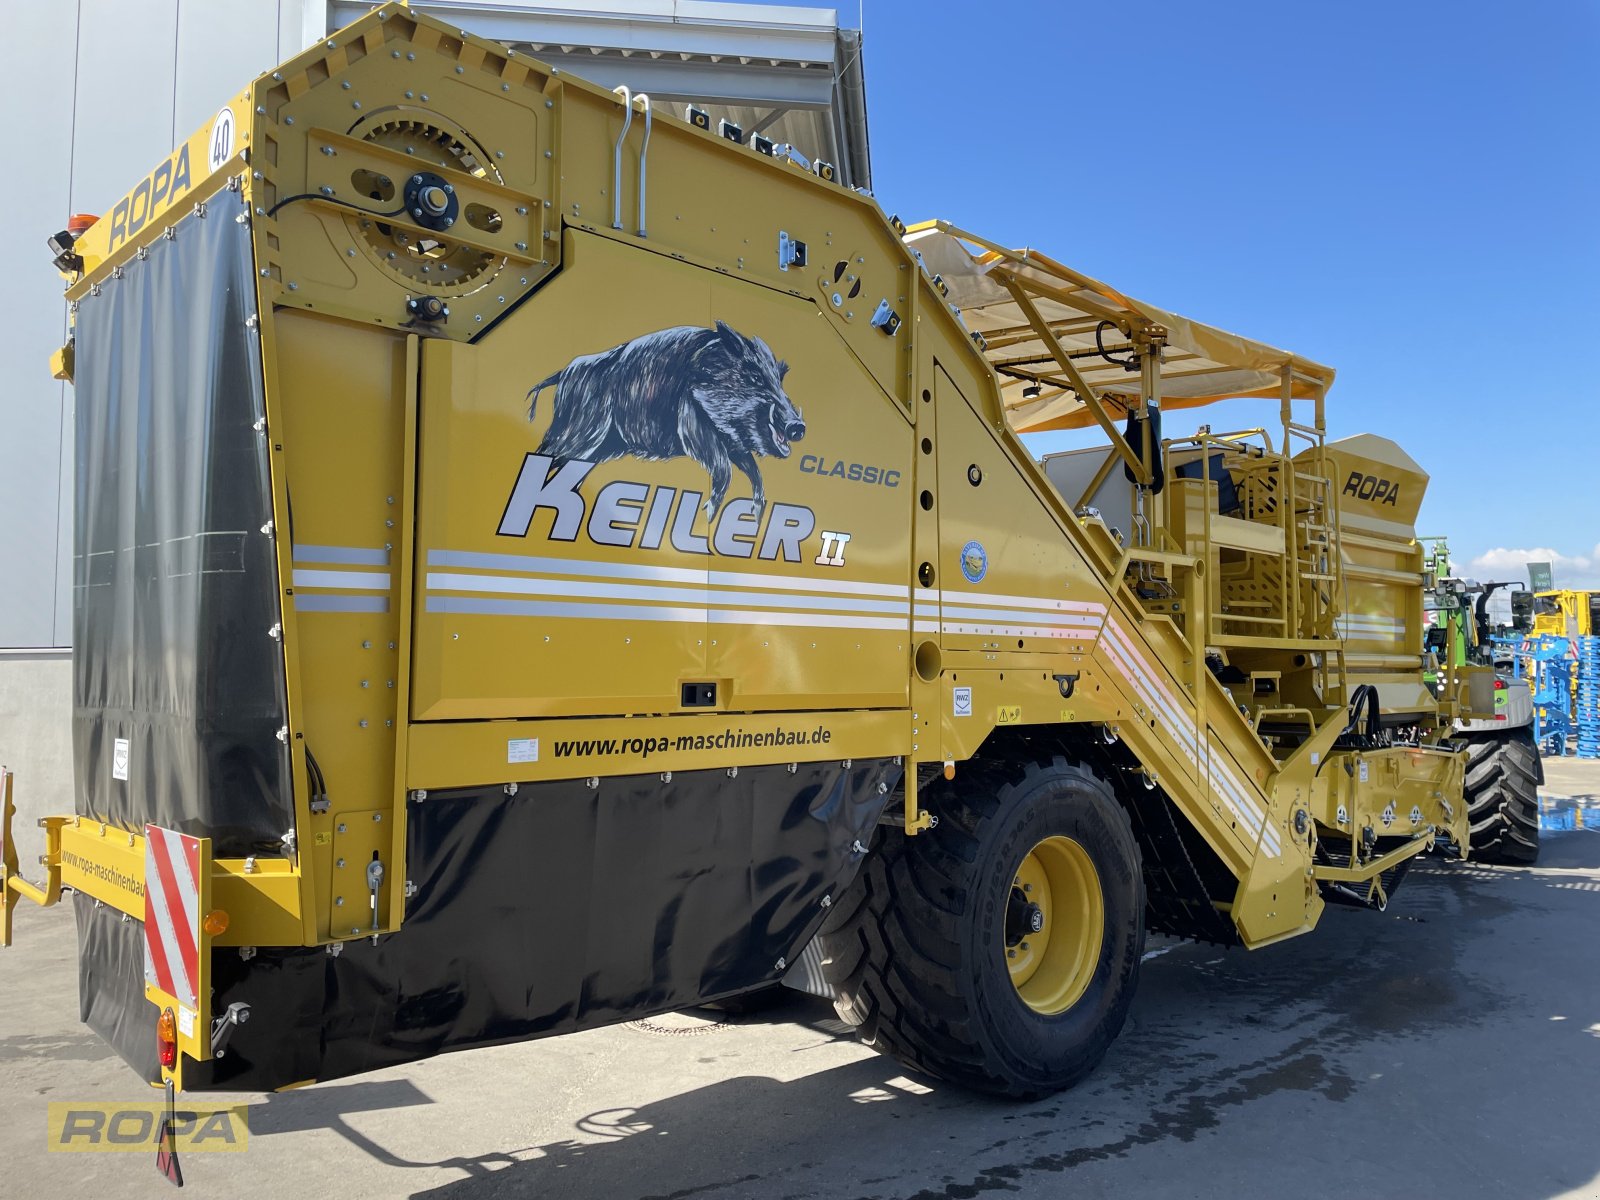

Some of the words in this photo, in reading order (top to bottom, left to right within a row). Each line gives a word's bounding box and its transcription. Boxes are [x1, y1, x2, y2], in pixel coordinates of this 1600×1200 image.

[213, 119, 230, 165] 40
[109, 142, 192, 254] ROPA
[799, 455, 901, 488] CLASSIC
[1343, 471, 1400, 507] ROPA
[496, 453, 815, 563] KEILER
[815, 531, 852, 567] II
[957, 694, 969, 702] RWZ
[554, 726, 832, 759] www.ropa-maschinenbau.de
[62, 851, 146, 896] www.ropa-maschinenbau
